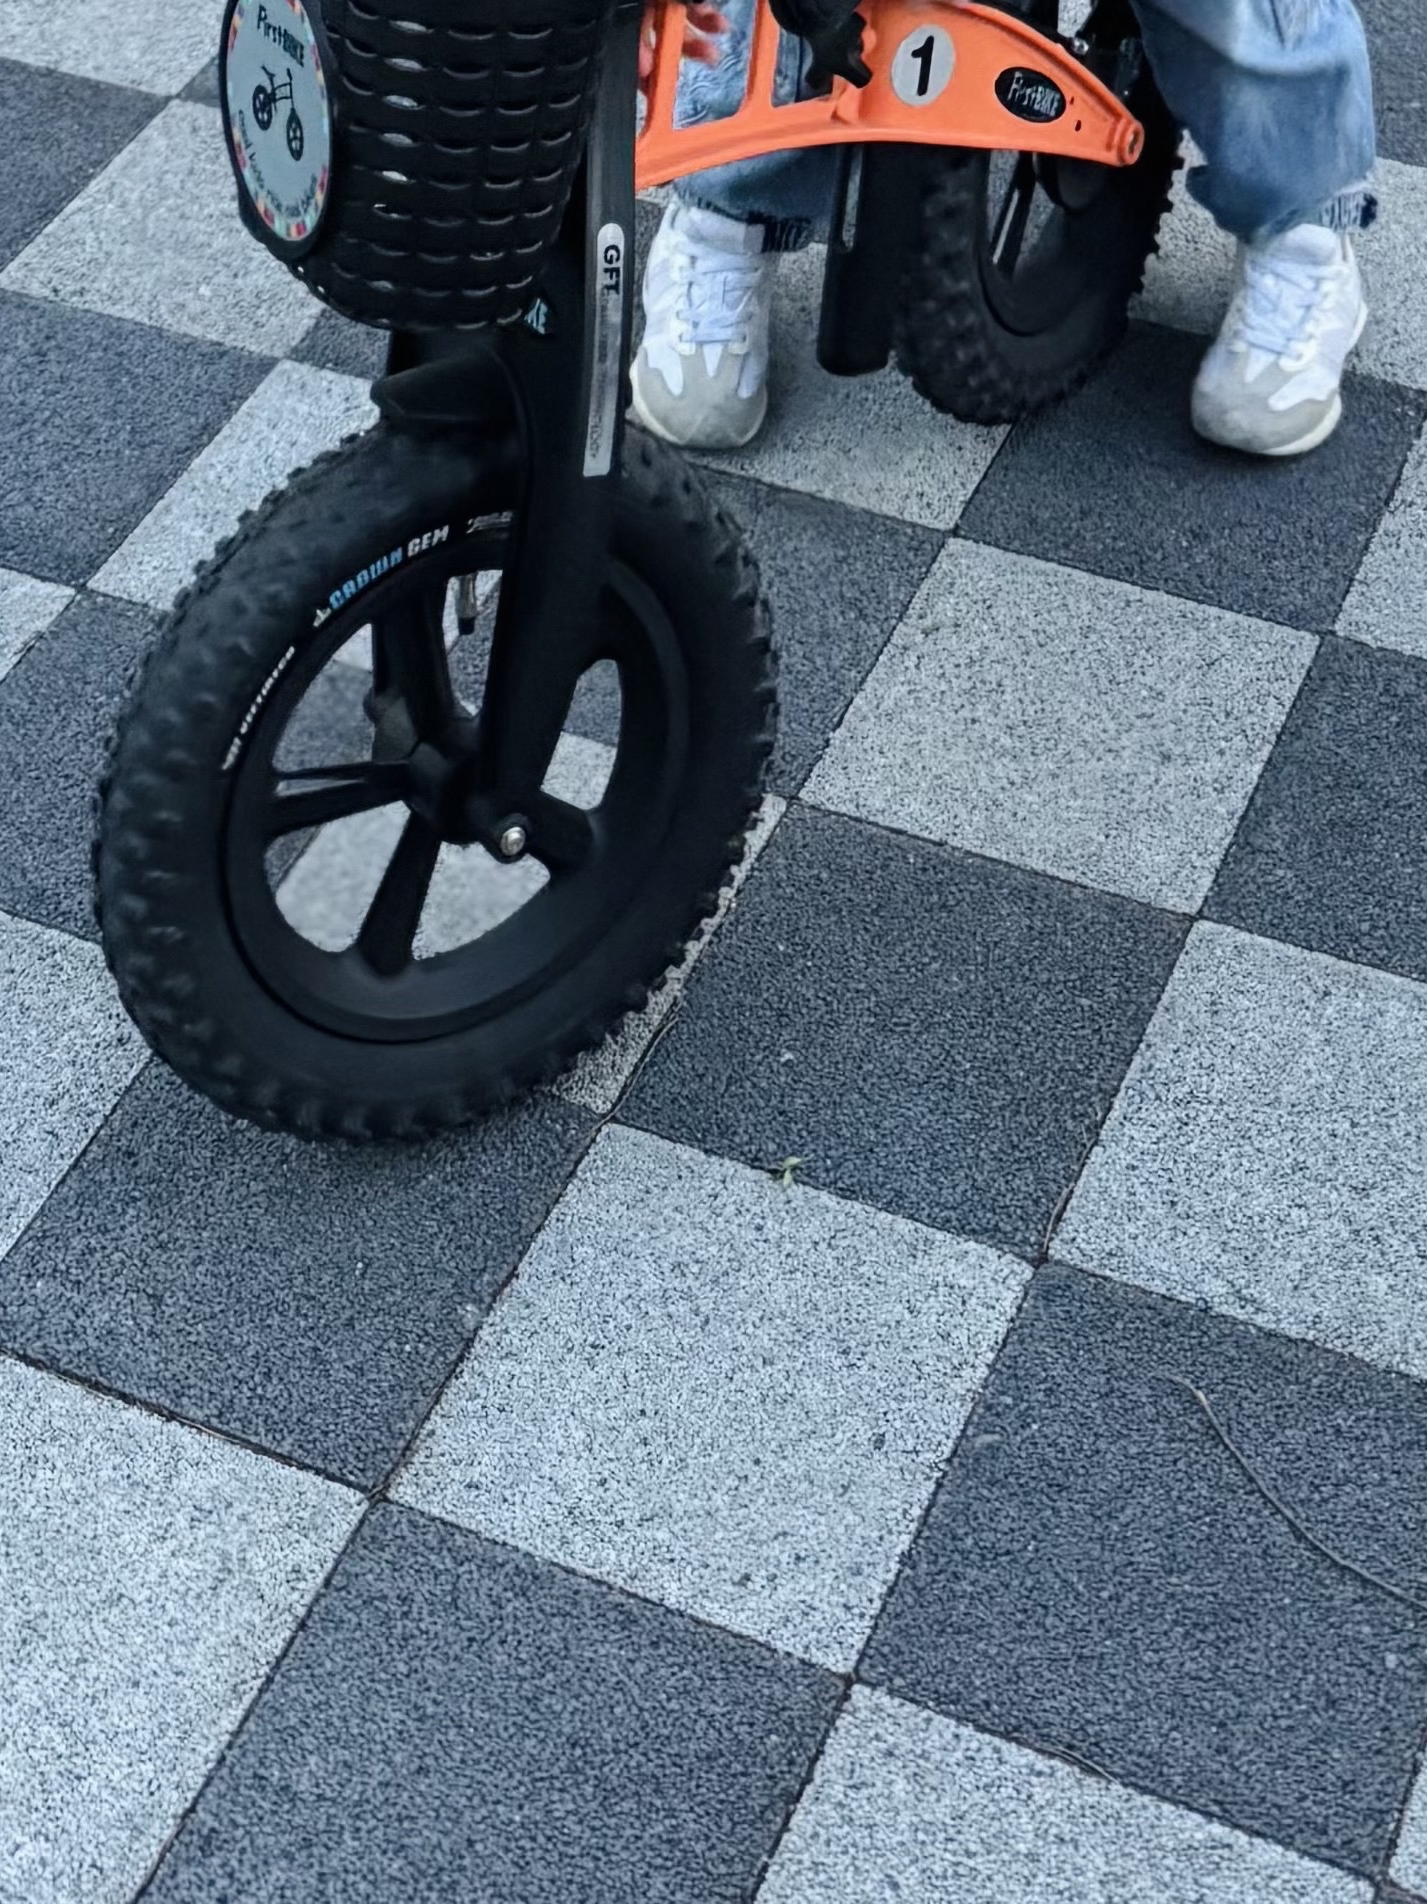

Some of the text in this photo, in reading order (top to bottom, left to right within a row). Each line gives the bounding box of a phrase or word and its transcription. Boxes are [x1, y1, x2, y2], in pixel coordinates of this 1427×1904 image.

[910, 35, 935, 97] 1
[603, 244, 621, 296] GFT
[407, 525, 449, 557] GEM
